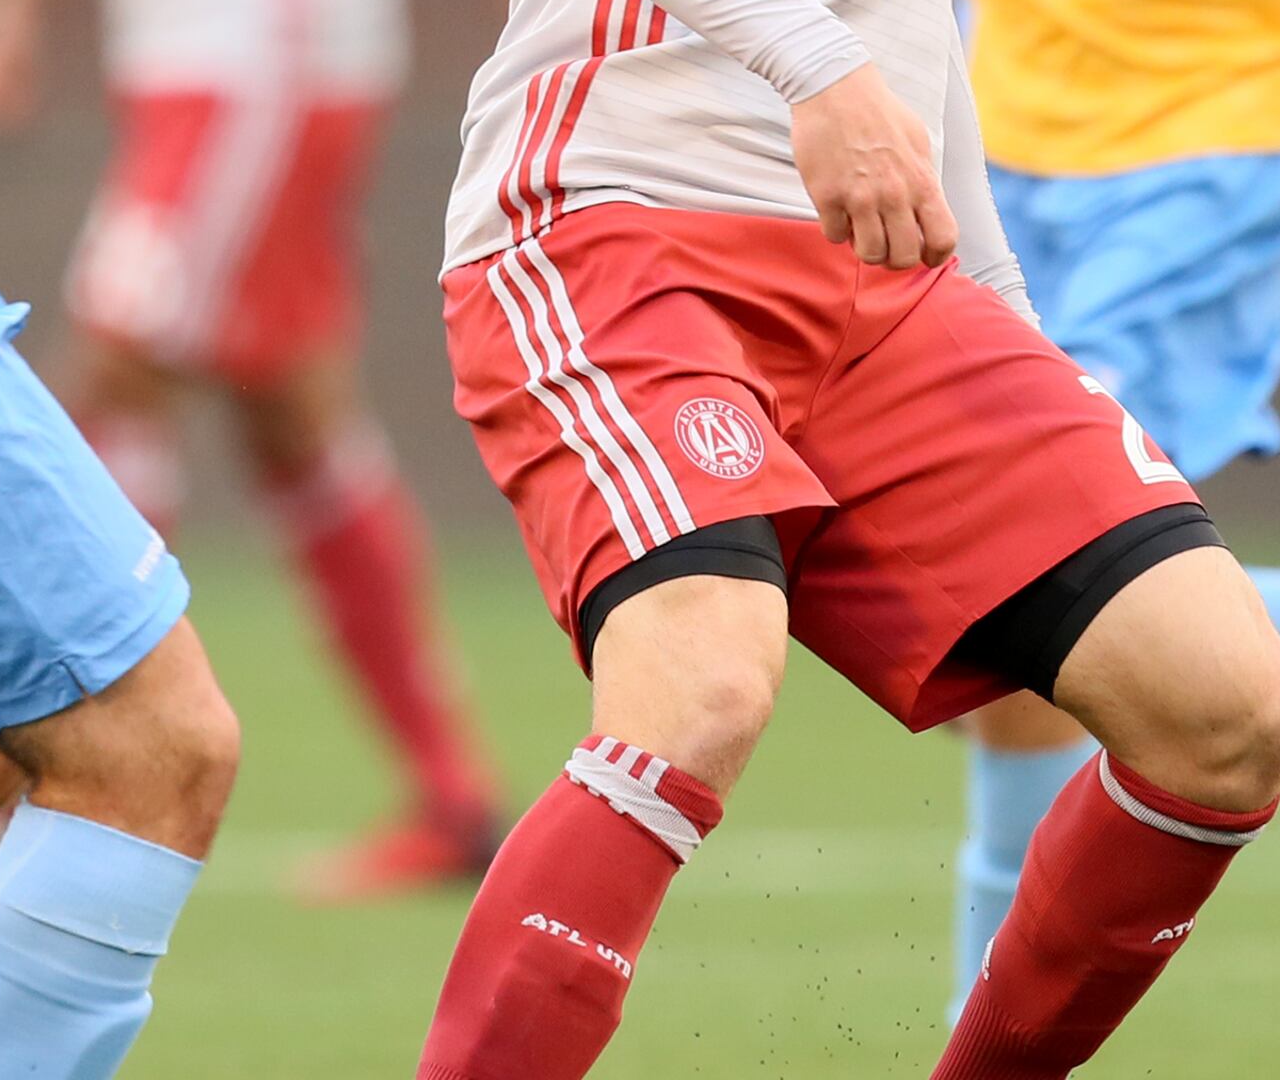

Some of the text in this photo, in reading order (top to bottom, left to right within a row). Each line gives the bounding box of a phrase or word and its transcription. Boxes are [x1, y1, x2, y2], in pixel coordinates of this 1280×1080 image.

[680, 401, 735, 425] ATLANTA
[699, 448, 761, 476] UNITED FC
[521, 913, 588, 947] ATL
